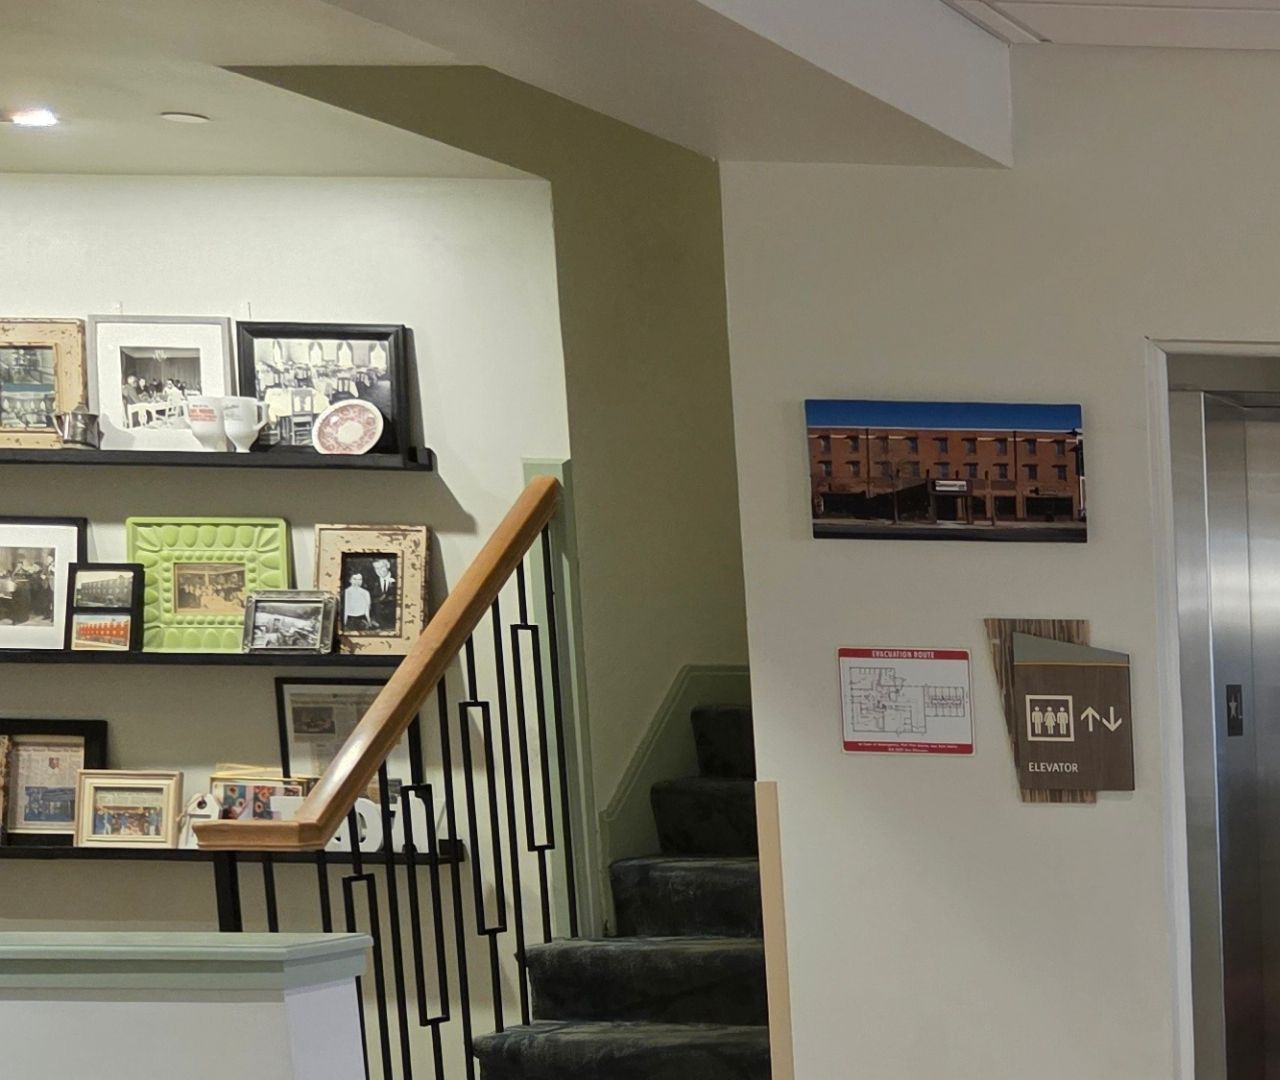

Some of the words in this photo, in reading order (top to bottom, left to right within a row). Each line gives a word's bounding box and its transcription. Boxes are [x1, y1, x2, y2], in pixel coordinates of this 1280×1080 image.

[871, 650, 912, 658] EVACUATION
[913, 651, 935, 659] ROUTE
[1028, 762, 1079, 773] ELEVATOR
